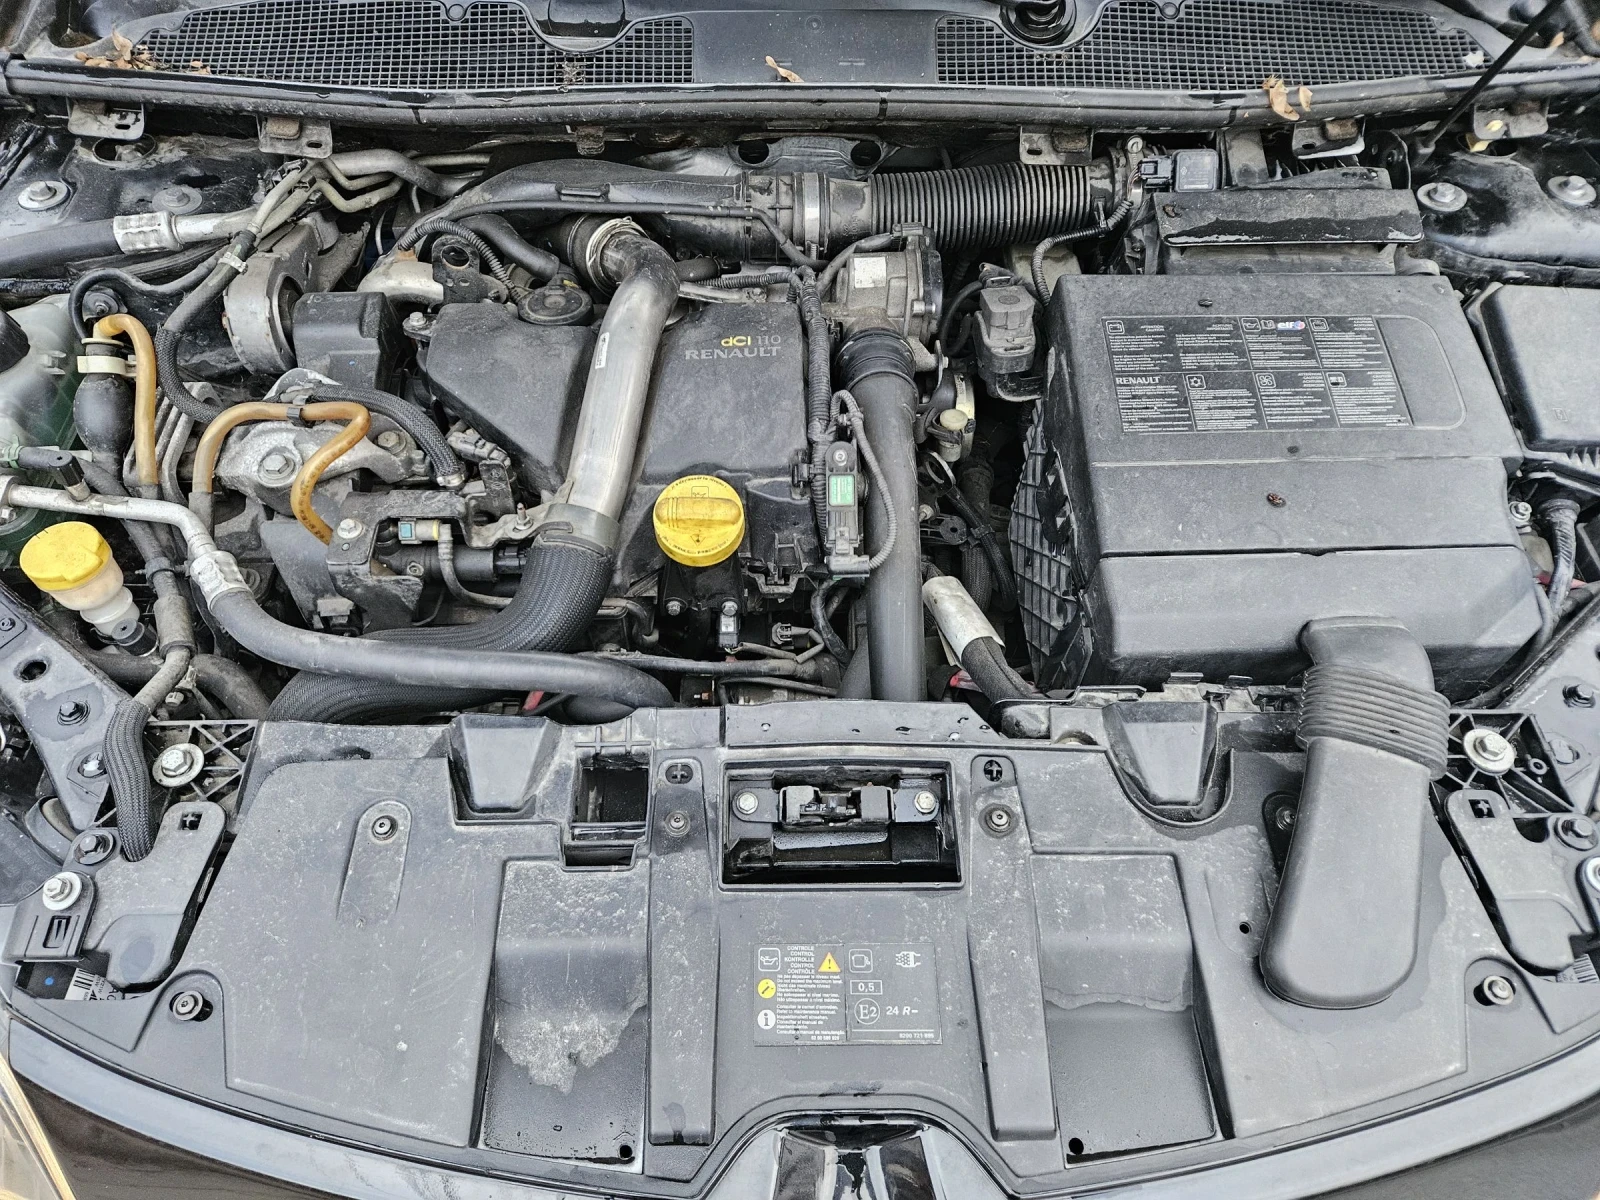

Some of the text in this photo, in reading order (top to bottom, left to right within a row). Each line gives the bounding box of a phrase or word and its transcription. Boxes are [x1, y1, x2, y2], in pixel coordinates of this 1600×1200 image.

[1277, 320, 1295, 329] elf
[756, 334, 781, 346] 110
[685, 346, 781, 360] RENAULT
[858, 983, 874, 992] 0,5
[859, 1004, 877, 1019] E2
[886, 1006, 899, 1015] 24
